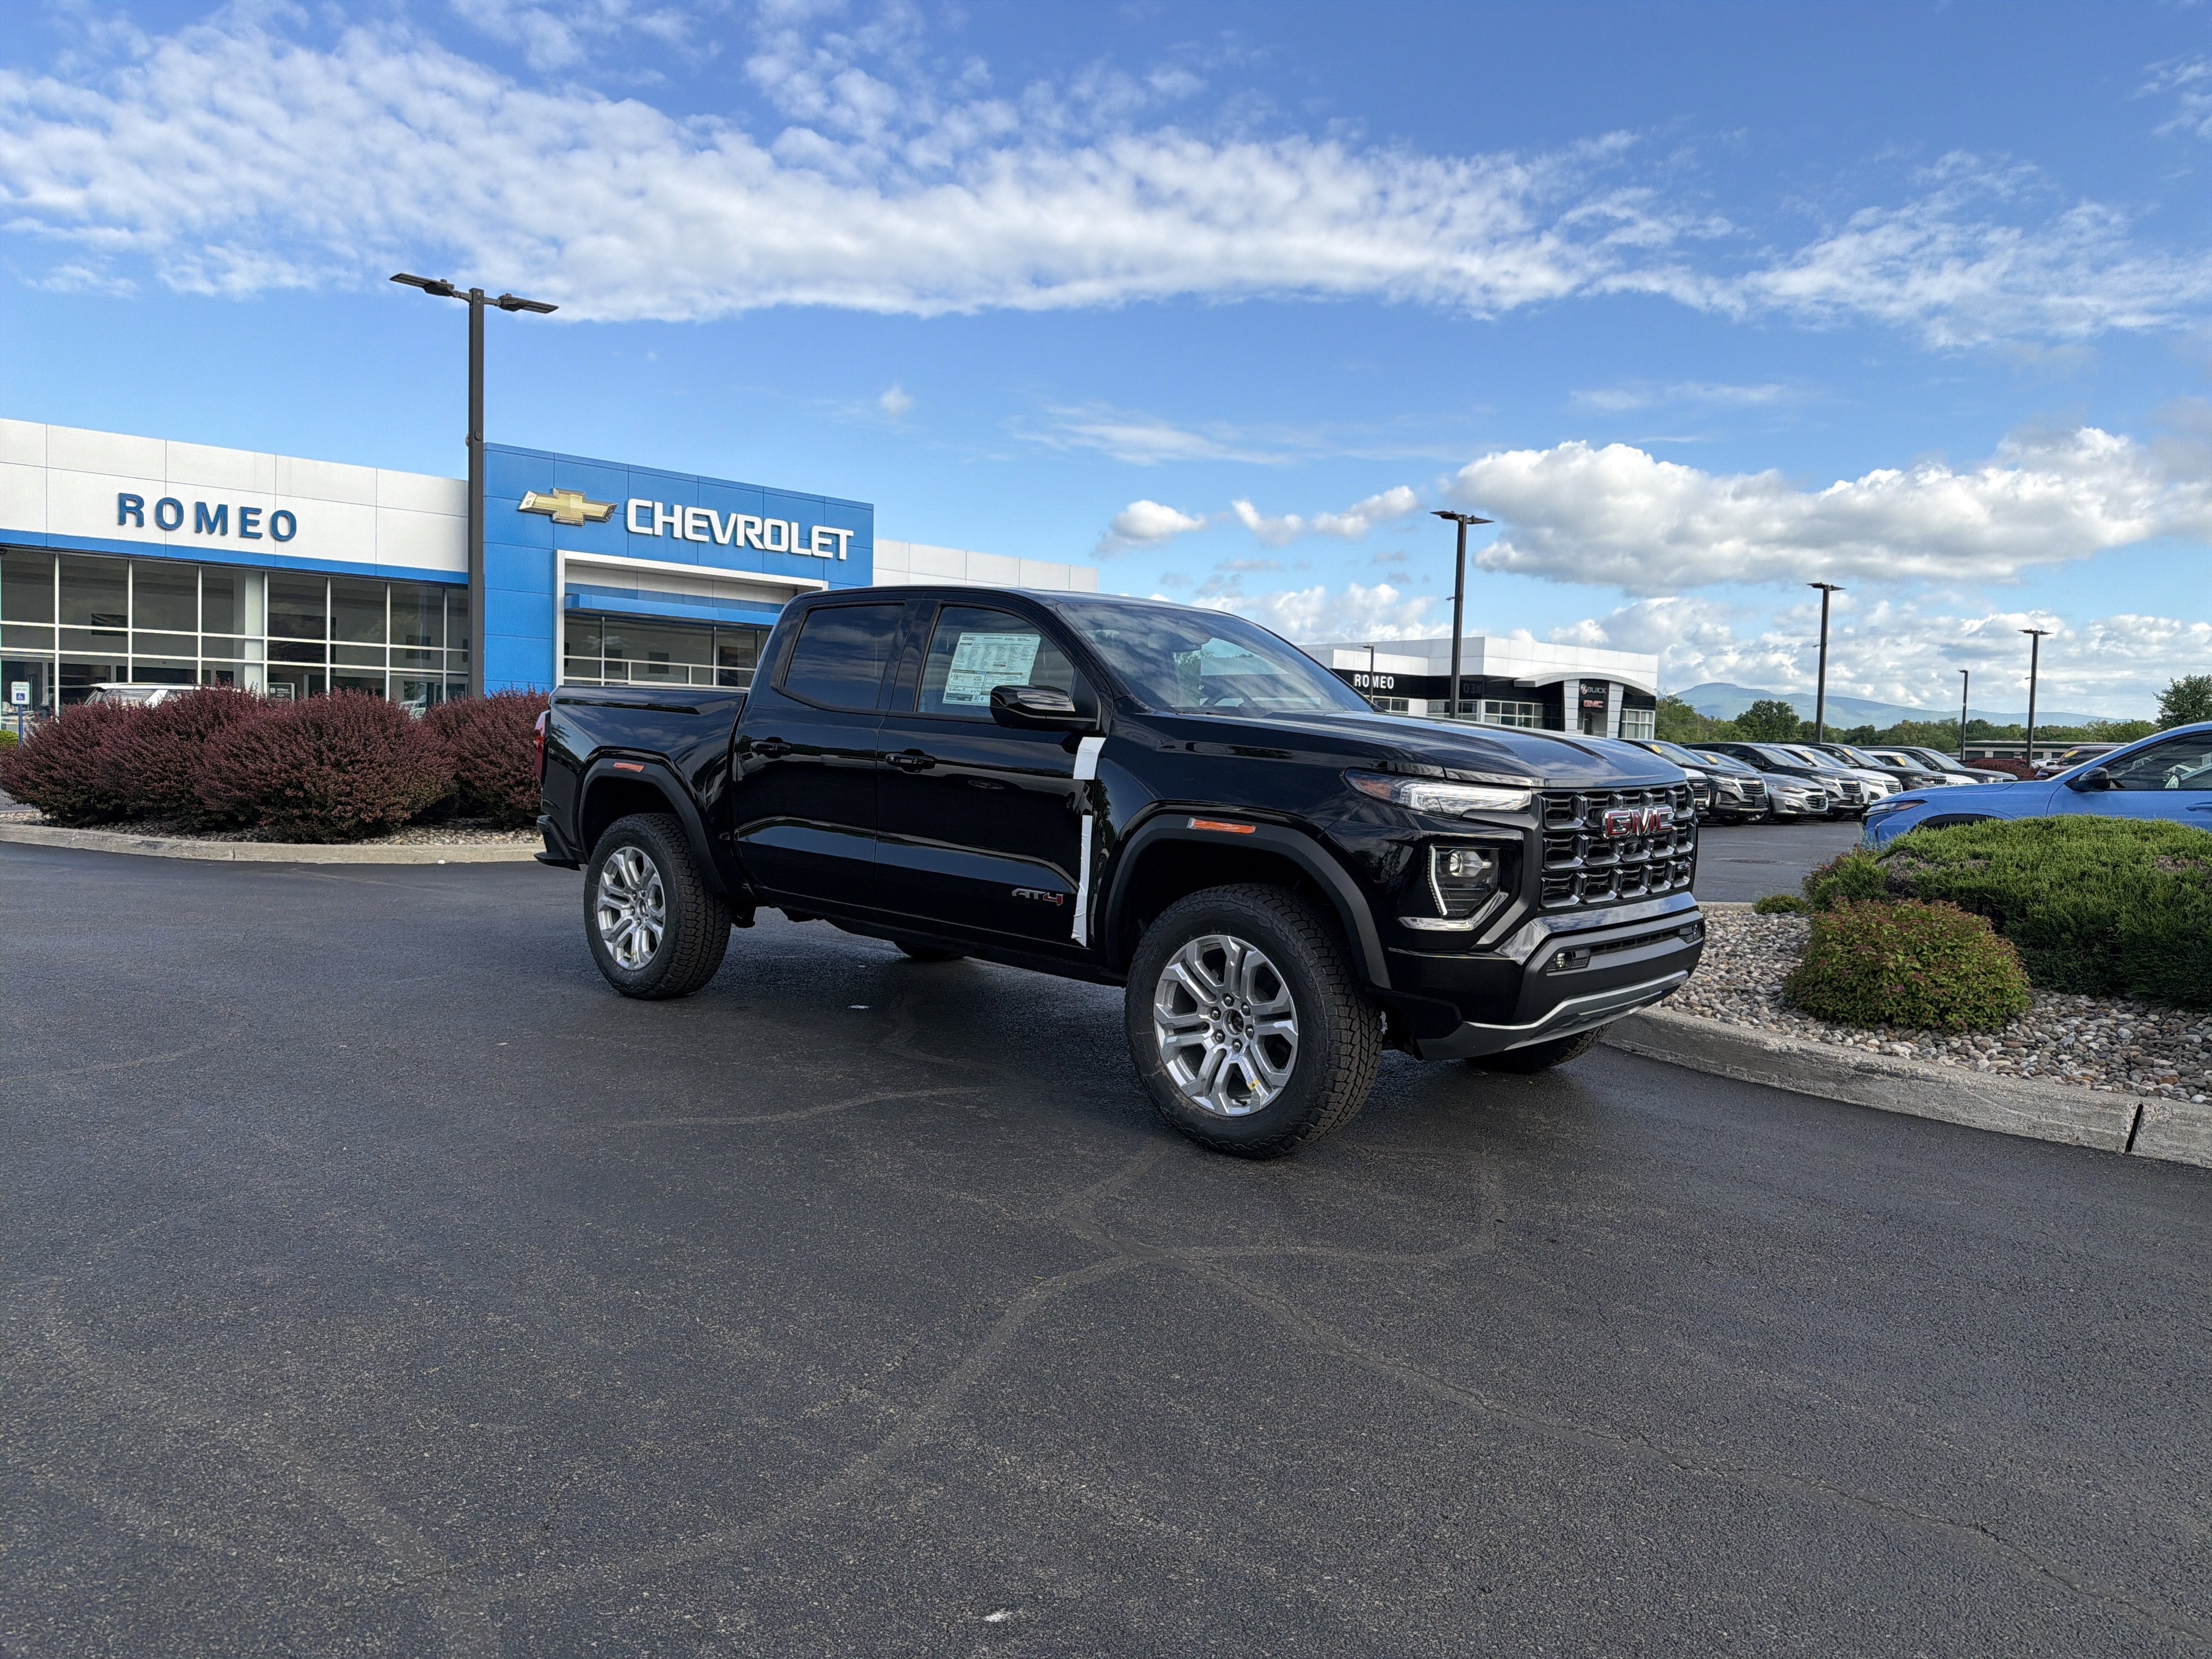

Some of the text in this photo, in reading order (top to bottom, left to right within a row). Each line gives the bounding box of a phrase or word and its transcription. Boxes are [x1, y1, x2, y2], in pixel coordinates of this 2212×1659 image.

[118, 493, 297, 541] ROMEO
[628, 499, 854, 560] CHEVROLET
[1353, 674, 1394, 689] ROMEO
[1583, 699, 1604, 708] GMC
[1604, 806, 1674, 838] GMC
[1012, 888, 1063, 906] AT4
